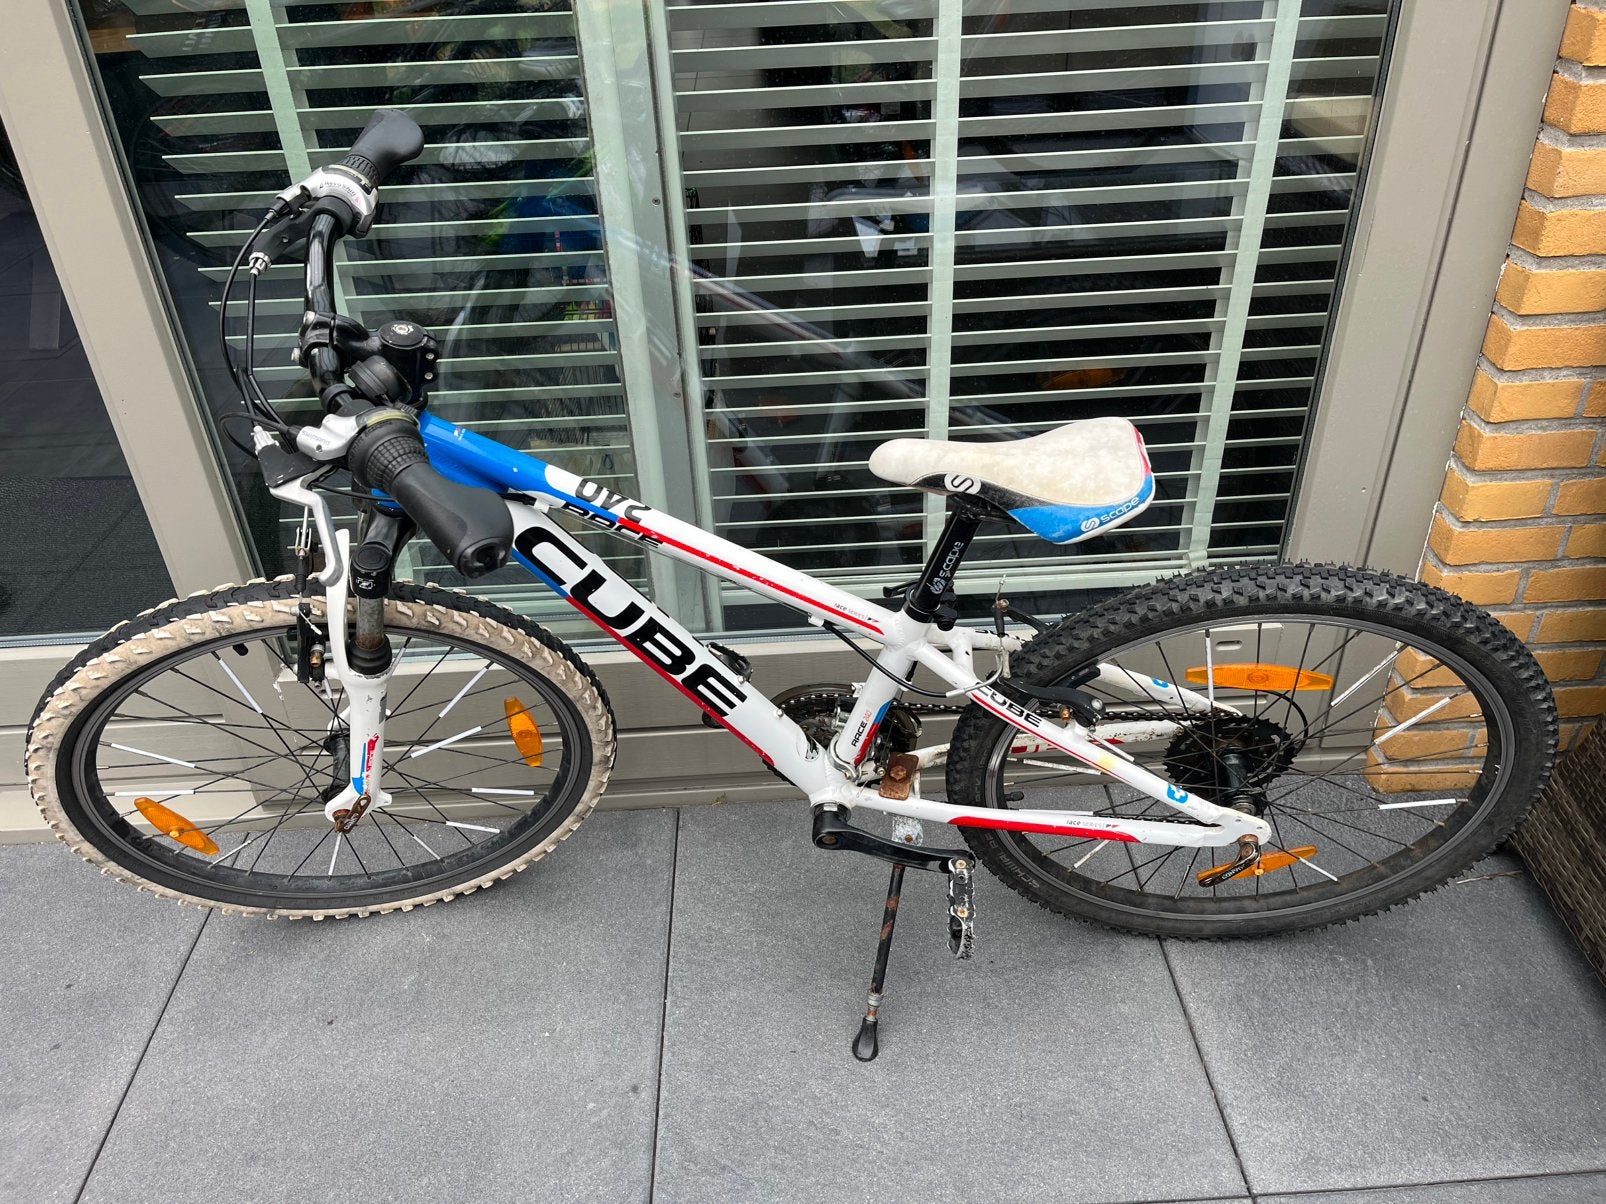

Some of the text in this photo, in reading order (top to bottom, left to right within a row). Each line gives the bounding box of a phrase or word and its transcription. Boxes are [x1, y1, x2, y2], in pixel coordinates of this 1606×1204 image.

[1100, 496, 1140, 524] scape
[514, 526, 748, 717] CUBE
[974, 681, 1043, 728] CUBE
[851, 720, 867, 748] RACE
